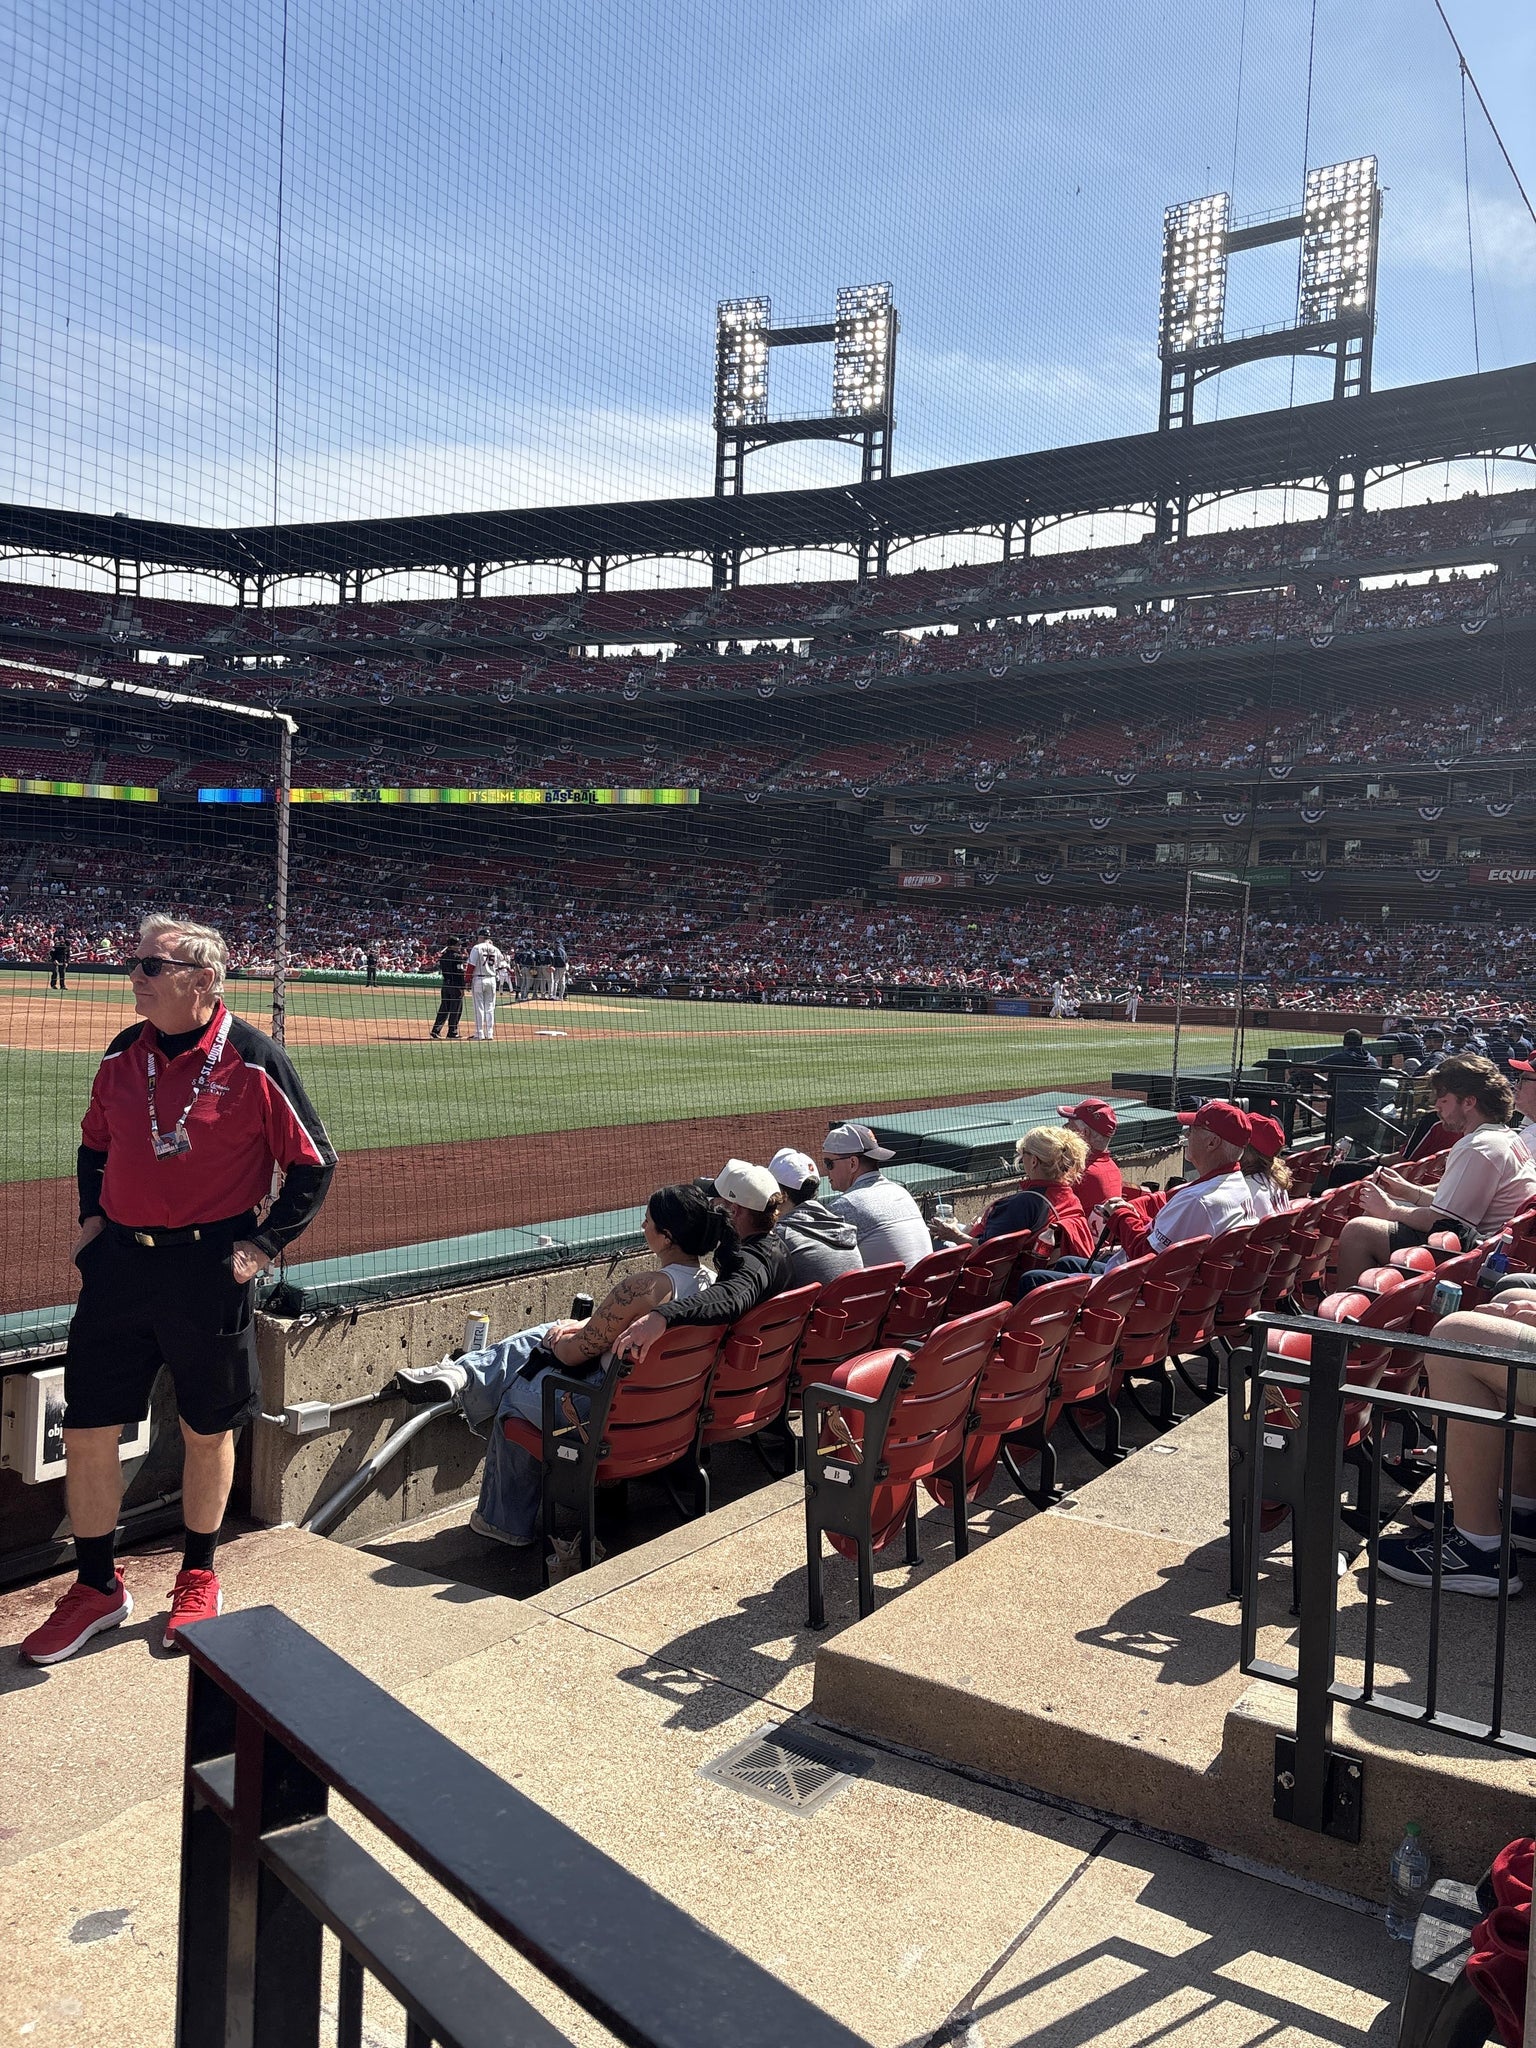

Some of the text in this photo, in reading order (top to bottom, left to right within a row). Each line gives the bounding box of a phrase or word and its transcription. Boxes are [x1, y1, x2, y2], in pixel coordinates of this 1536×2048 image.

[468, 789, 599, 804] IT'S TIME FOR BASEBALL
[206, 1042, 221, 1066] LOUIS
[201, 1065, 214, 1076] ST.
[1265, 1436, 1272, 1445] C
[833, 1470, 840, 1479] B
